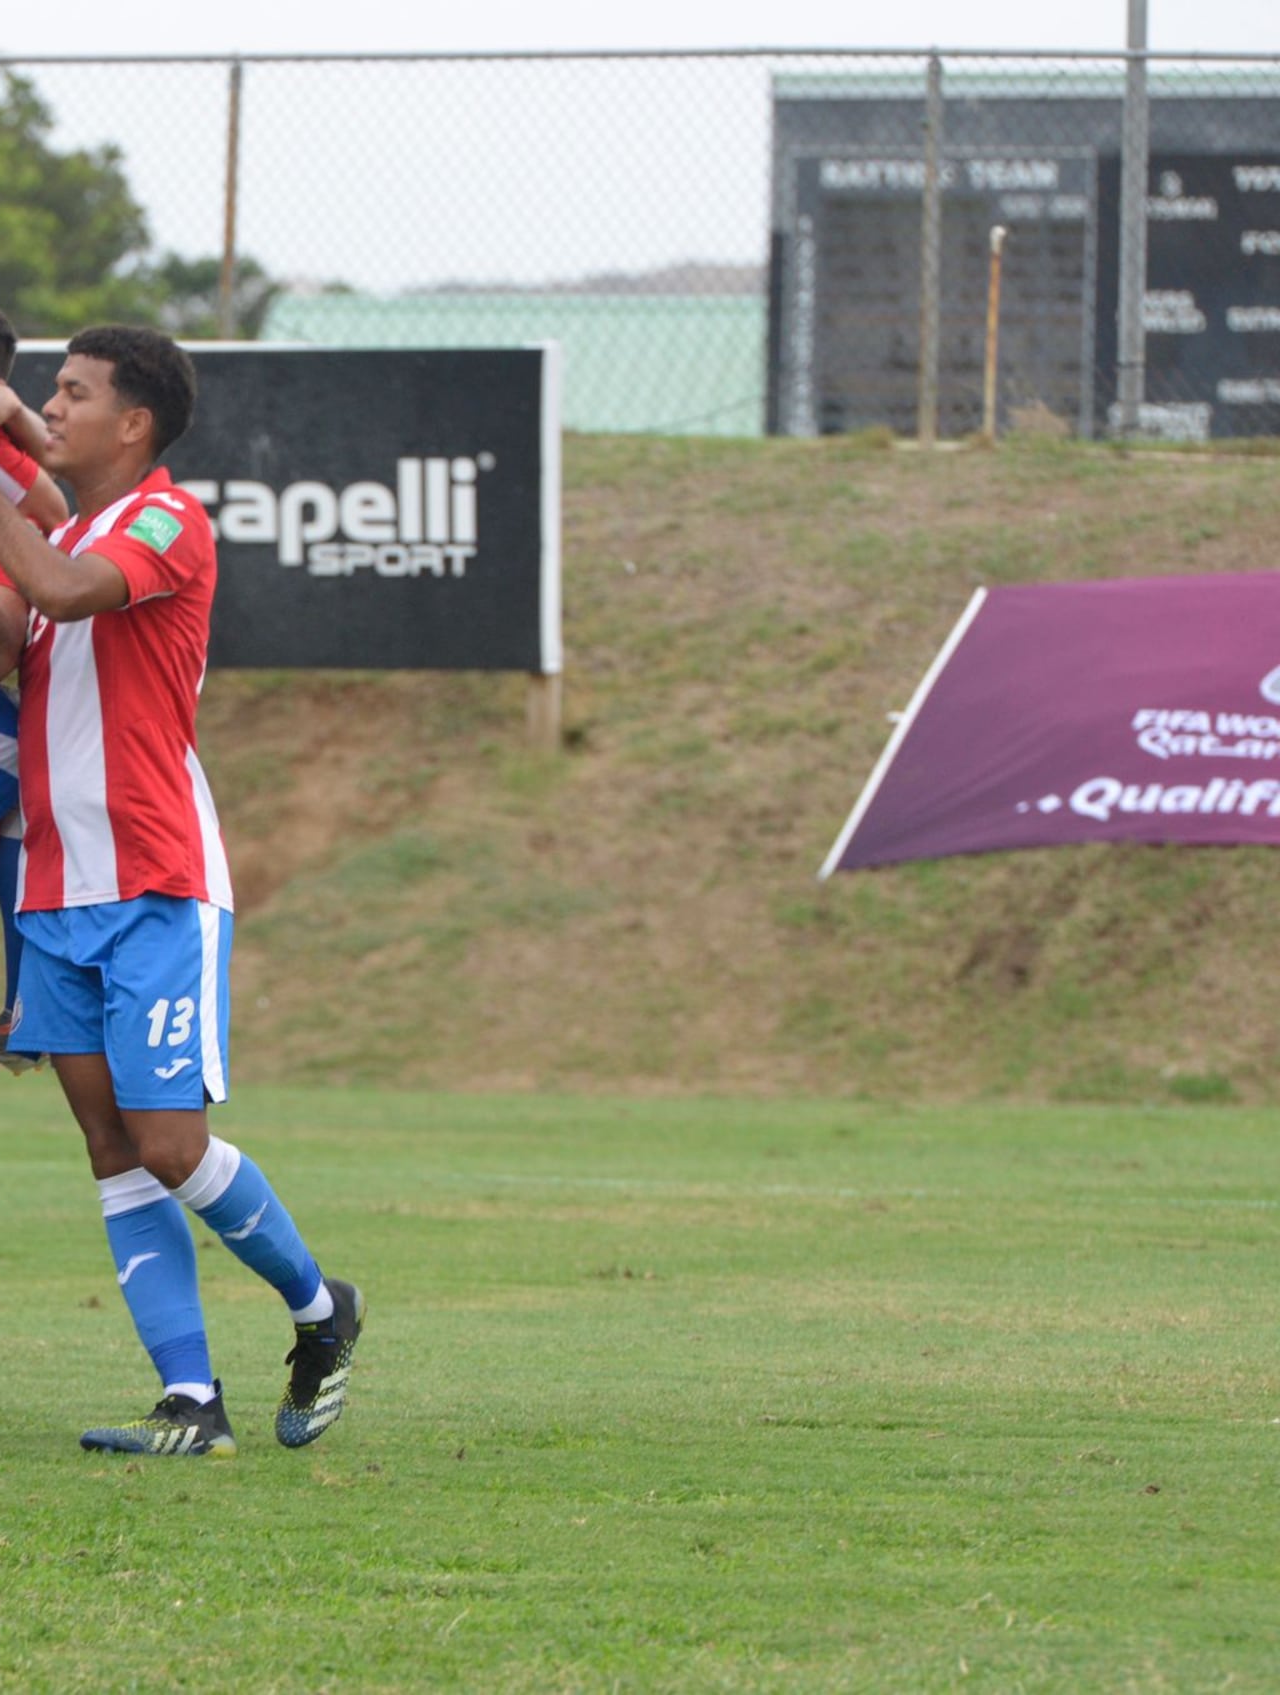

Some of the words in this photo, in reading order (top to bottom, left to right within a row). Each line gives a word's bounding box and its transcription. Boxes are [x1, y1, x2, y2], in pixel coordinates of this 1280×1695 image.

[308, 543, 477, 578] SPORT
[1131, 708, 1211, 734] FIFA
[1216, 711, 1280, 738] WO
[147, 996, 195, 1048] 13
